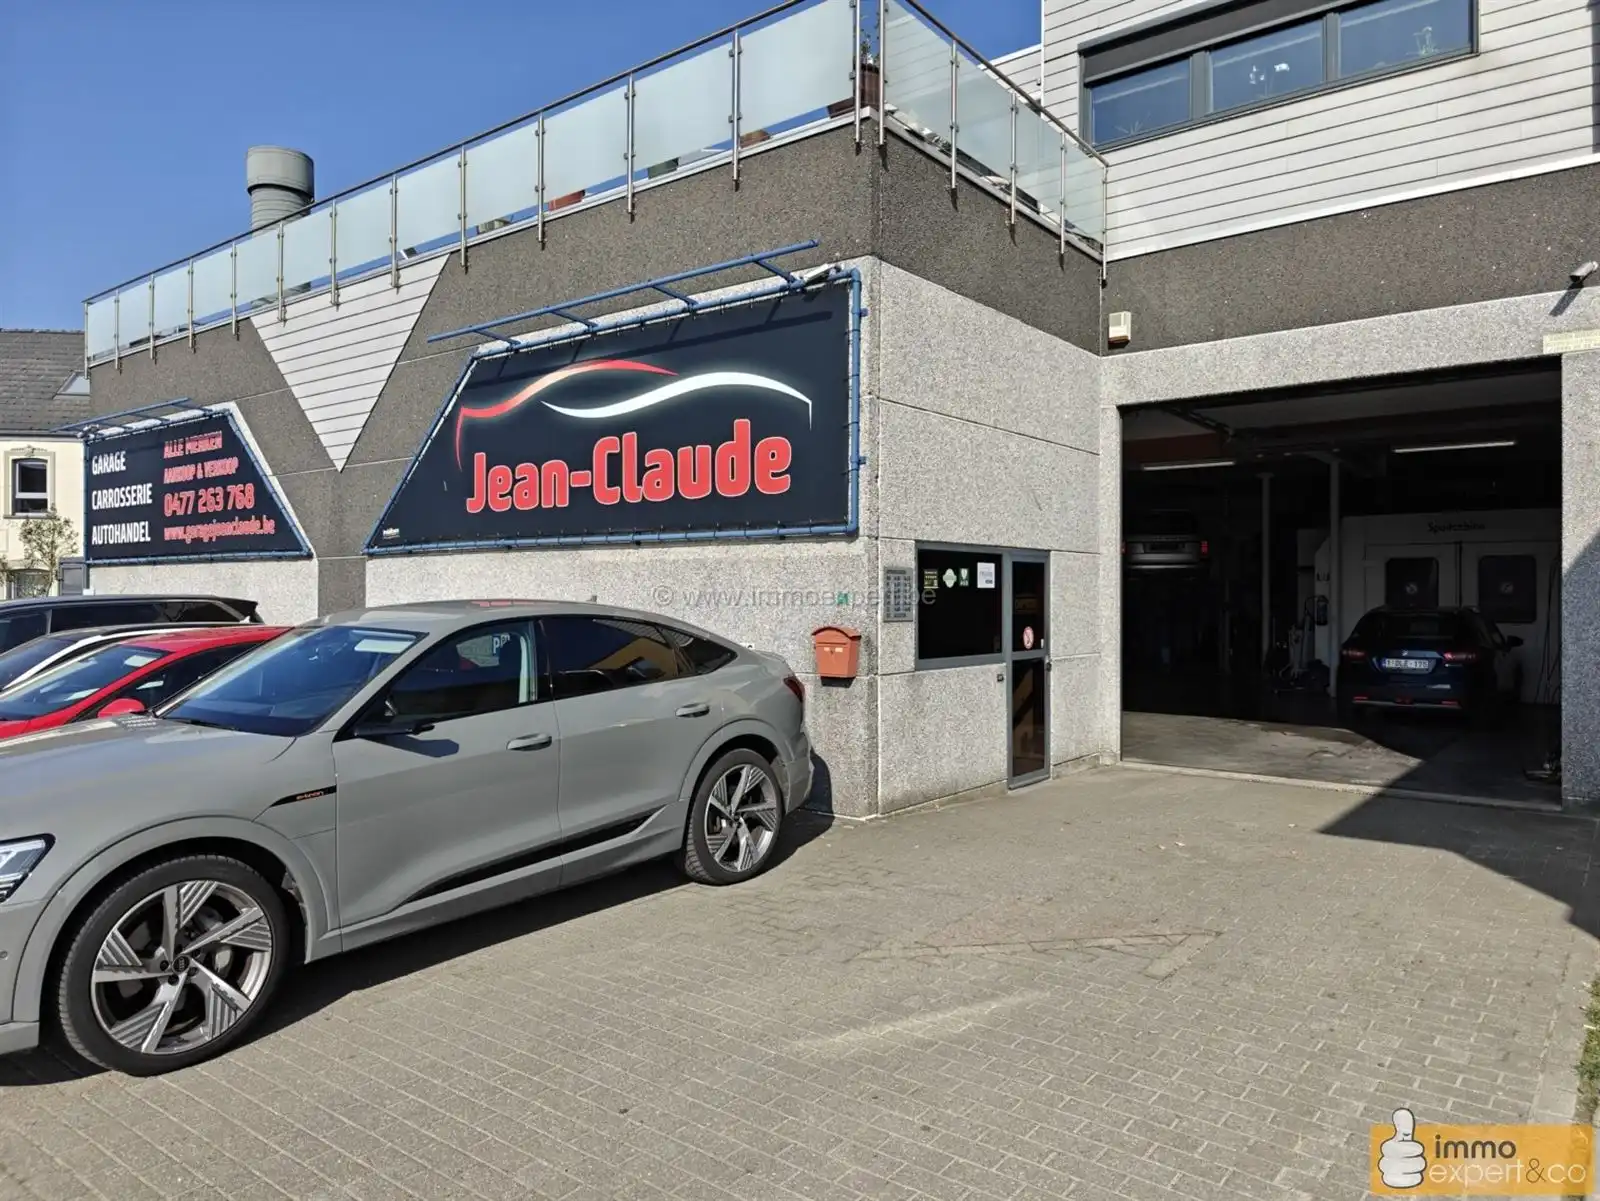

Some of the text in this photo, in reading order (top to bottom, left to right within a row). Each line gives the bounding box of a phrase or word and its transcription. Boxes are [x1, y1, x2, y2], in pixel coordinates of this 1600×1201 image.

[92, 450, 126, 475] GARAGE
[466, 419, 792, 513] Jean-Claude
[92, 482, 153, 511] CARROSSERIE
[164, 483, 255, 517] 0477 263 768
[92, 521, 151, 546] AUTOHANDEL
